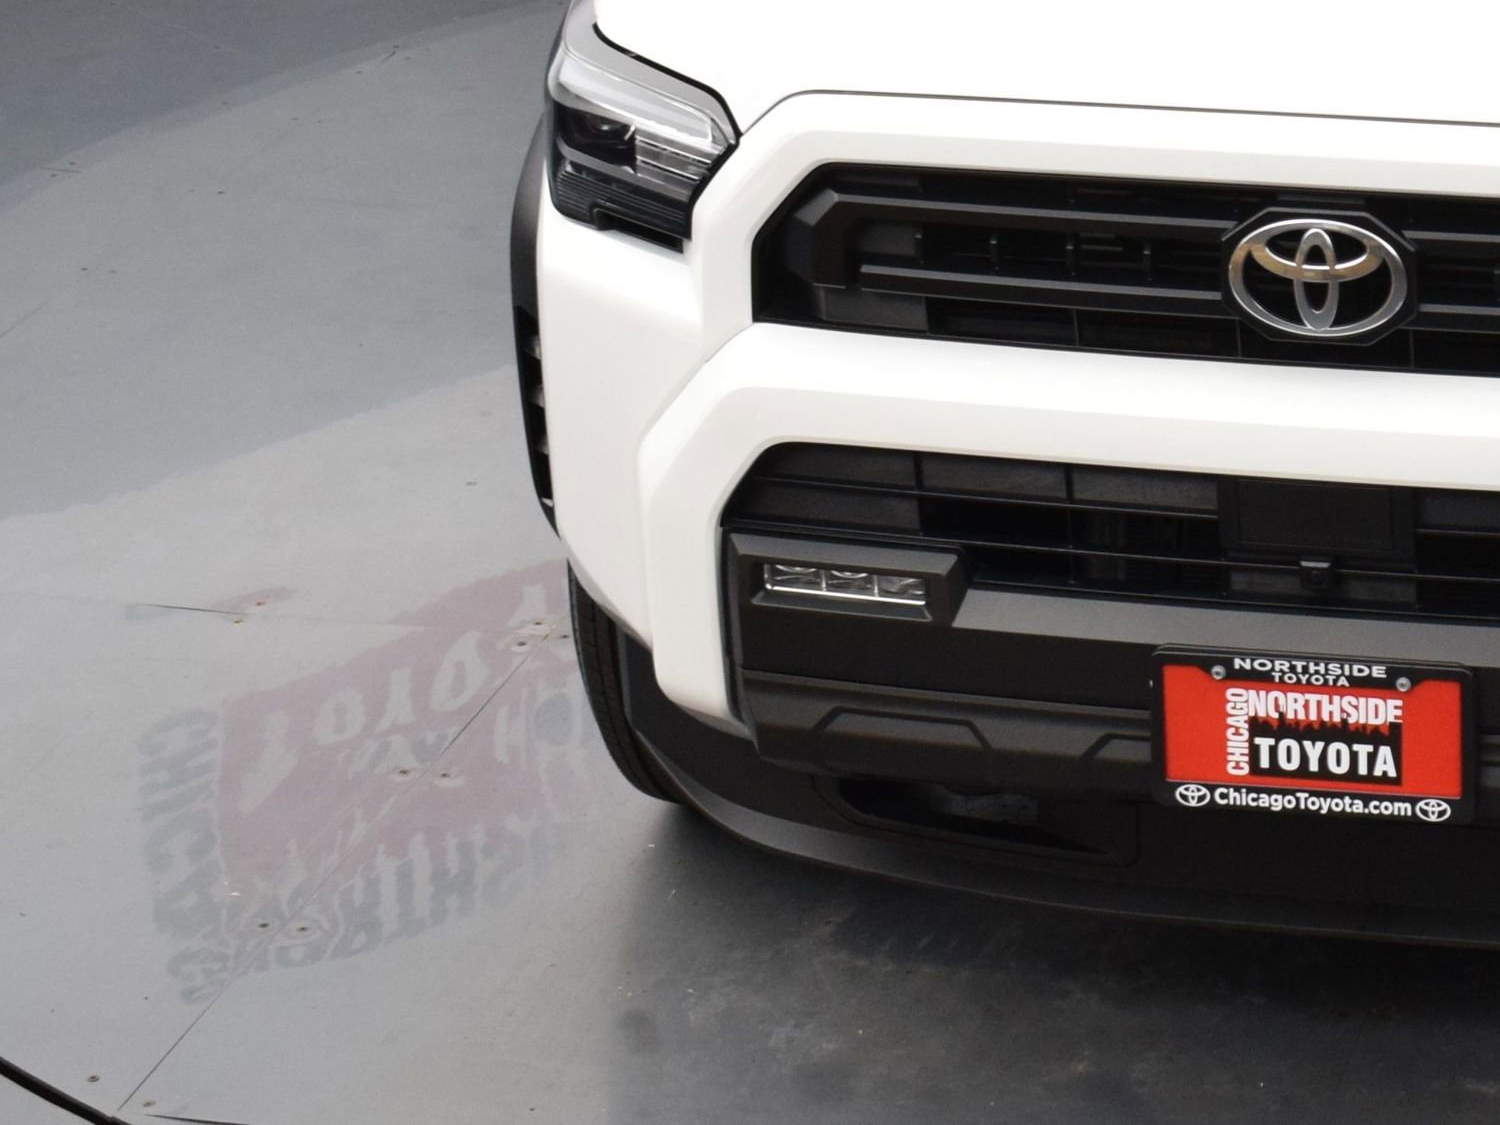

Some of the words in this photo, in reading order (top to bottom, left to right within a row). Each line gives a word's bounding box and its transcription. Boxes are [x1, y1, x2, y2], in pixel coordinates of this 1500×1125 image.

[1233, 658, 1387, 678] NORTHSIDE
[1272, 672, 1350, 687] TOYOTA
[1248, 690, 1404, 725] NORTHSIDE
[1225, 688, 1250, 776] CHICAGO
[1254, 737, 1398, 777] TOYOTA
[1214, 787, 1413, 816] ChicagoToyota.com
